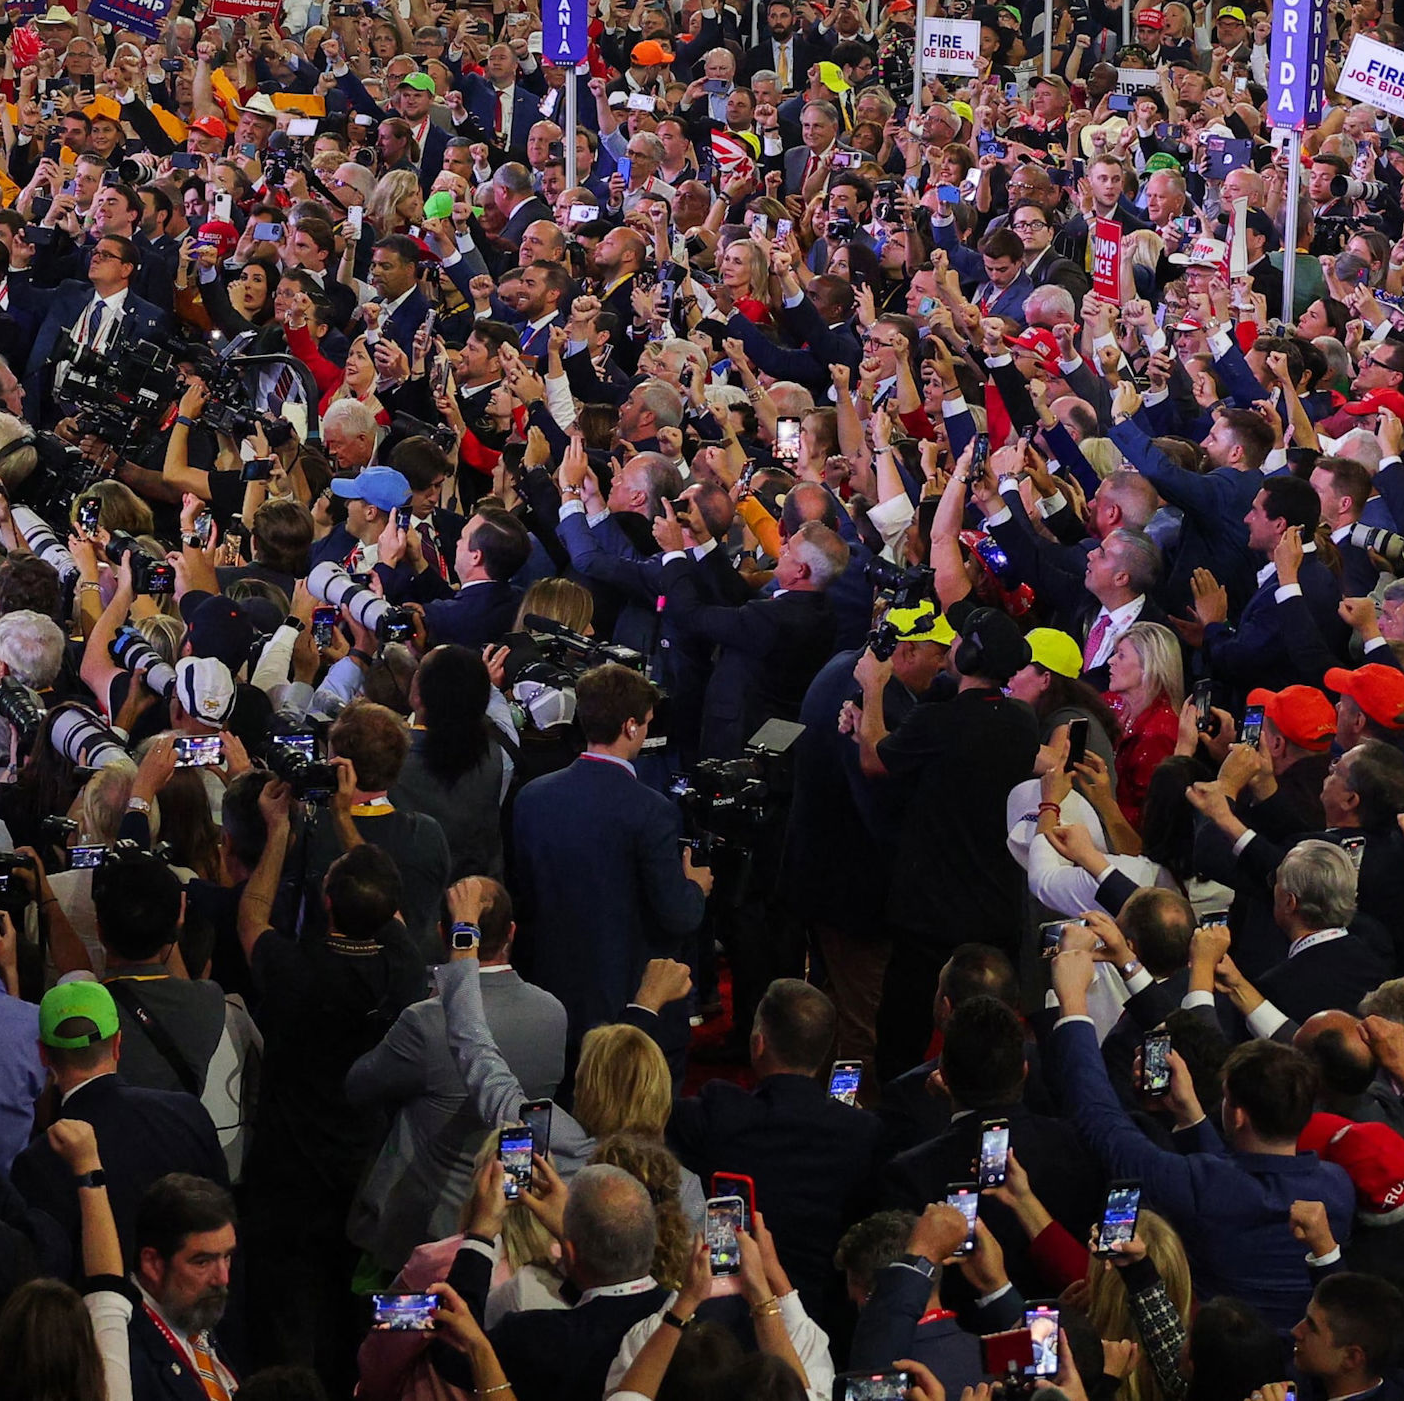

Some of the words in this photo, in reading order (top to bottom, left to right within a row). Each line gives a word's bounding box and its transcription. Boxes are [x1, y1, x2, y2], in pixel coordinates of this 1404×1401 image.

[260, 0, 278, 9] FIRST
[929, 33, 962, 49] FIRE
[923, 47, 937, 57] OE
[939, 48, 975, 61] BIDEN
[1347, 69, 1374, 87] JOE
[712, 797, 735, 807] RONIN
